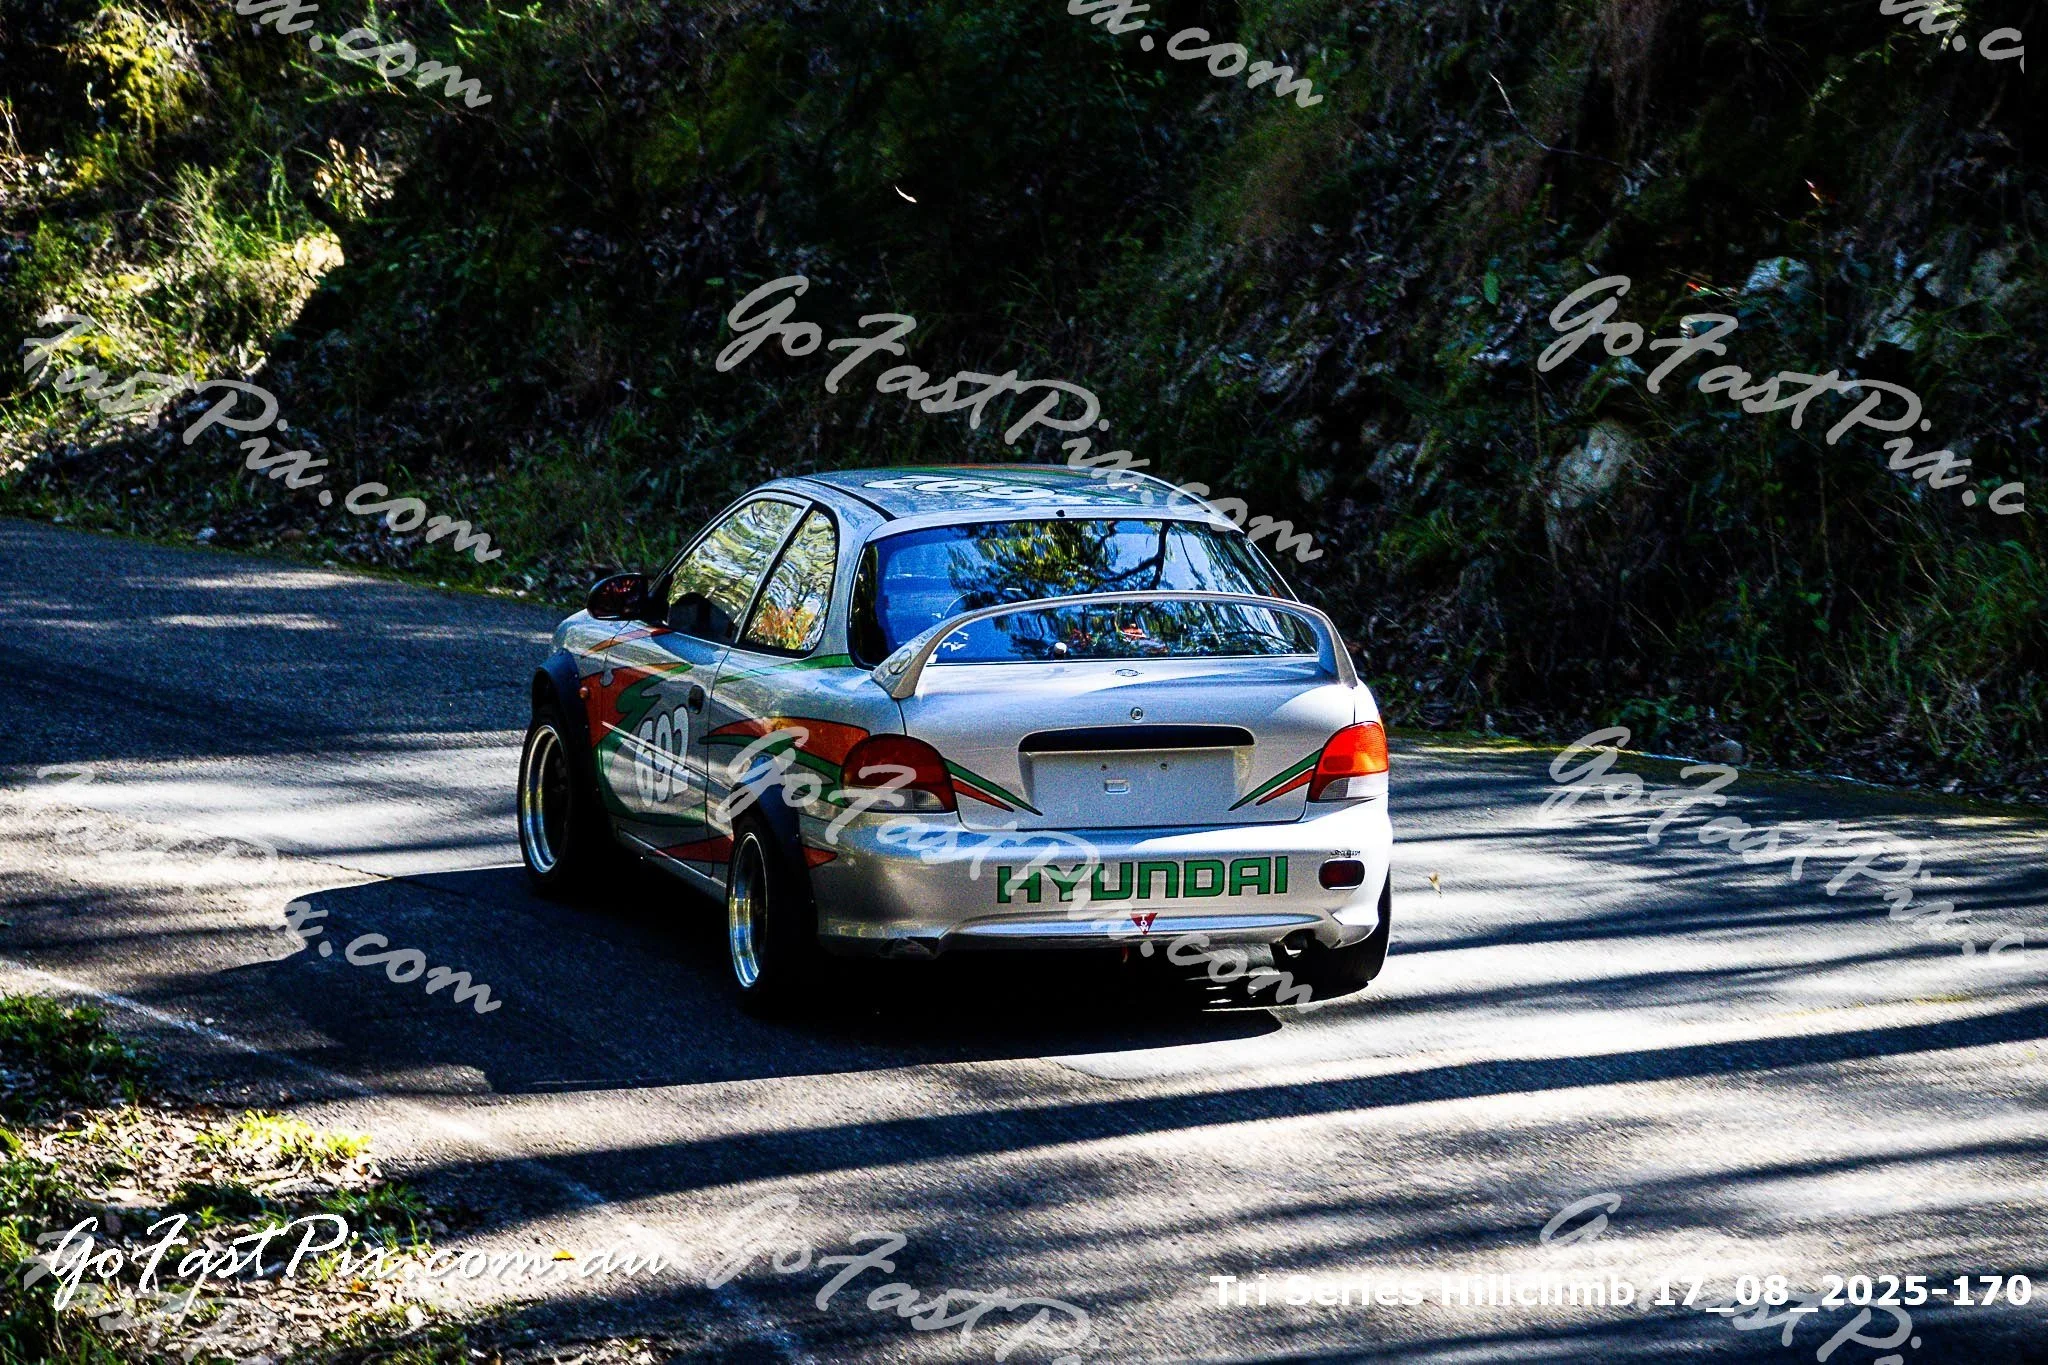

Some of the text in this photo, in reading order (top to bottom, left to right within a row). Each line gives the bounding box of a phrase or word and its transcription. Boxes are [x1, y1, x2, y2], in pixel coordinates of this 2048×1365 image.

[635, 705, 690, 808] 692
[997, 855, 1289, 903] HYUNDAI
[1139, 914, 1149, 931] TOW
